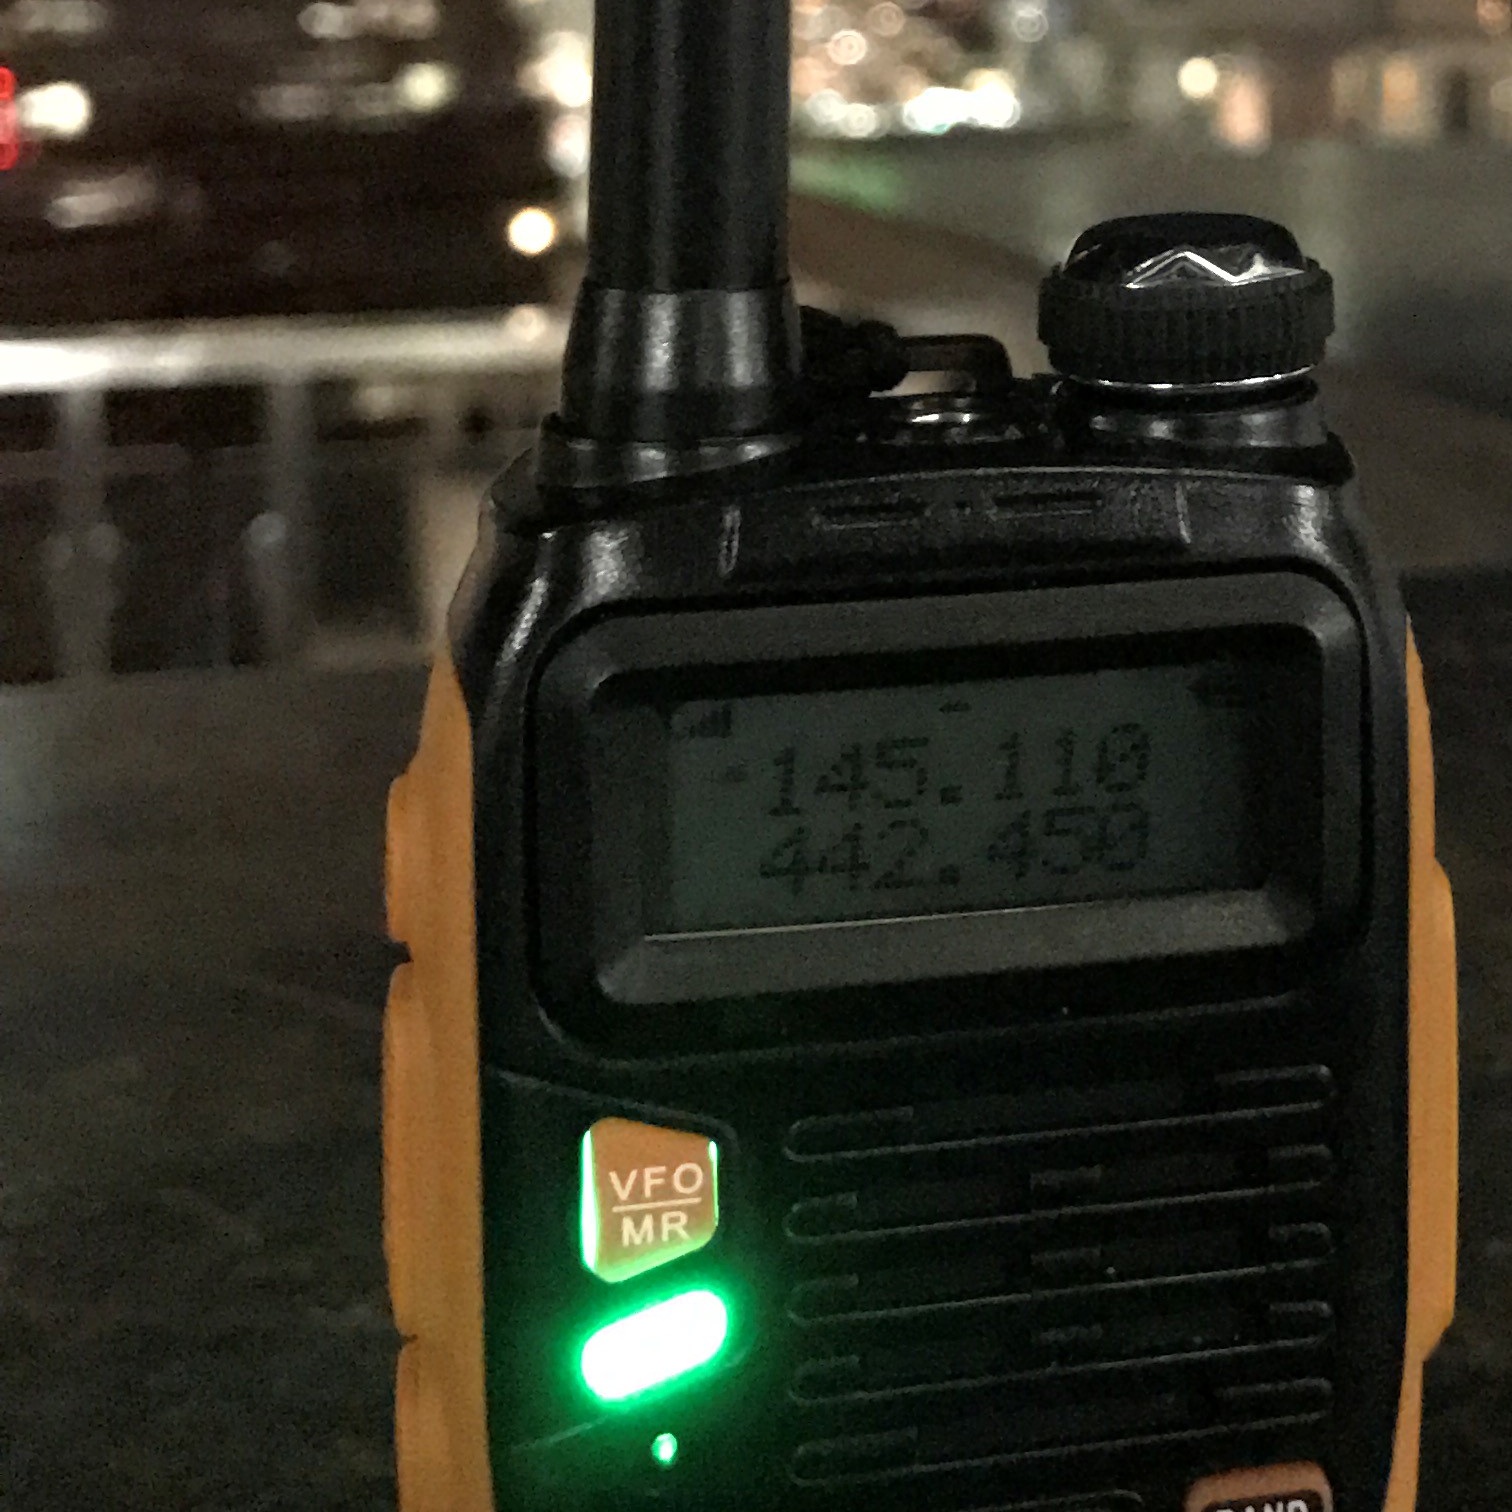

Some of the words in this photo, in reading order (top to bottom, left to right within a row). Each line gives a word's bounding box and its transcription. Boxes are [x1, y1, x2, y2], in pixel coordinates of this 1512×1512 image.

[768, 723, 1151, 817] 145.110
[759, 803, 1151, 894] 442.450
[608, 1162, 704, 1201] VFO
[621, 1210, 690, 1247] MR
